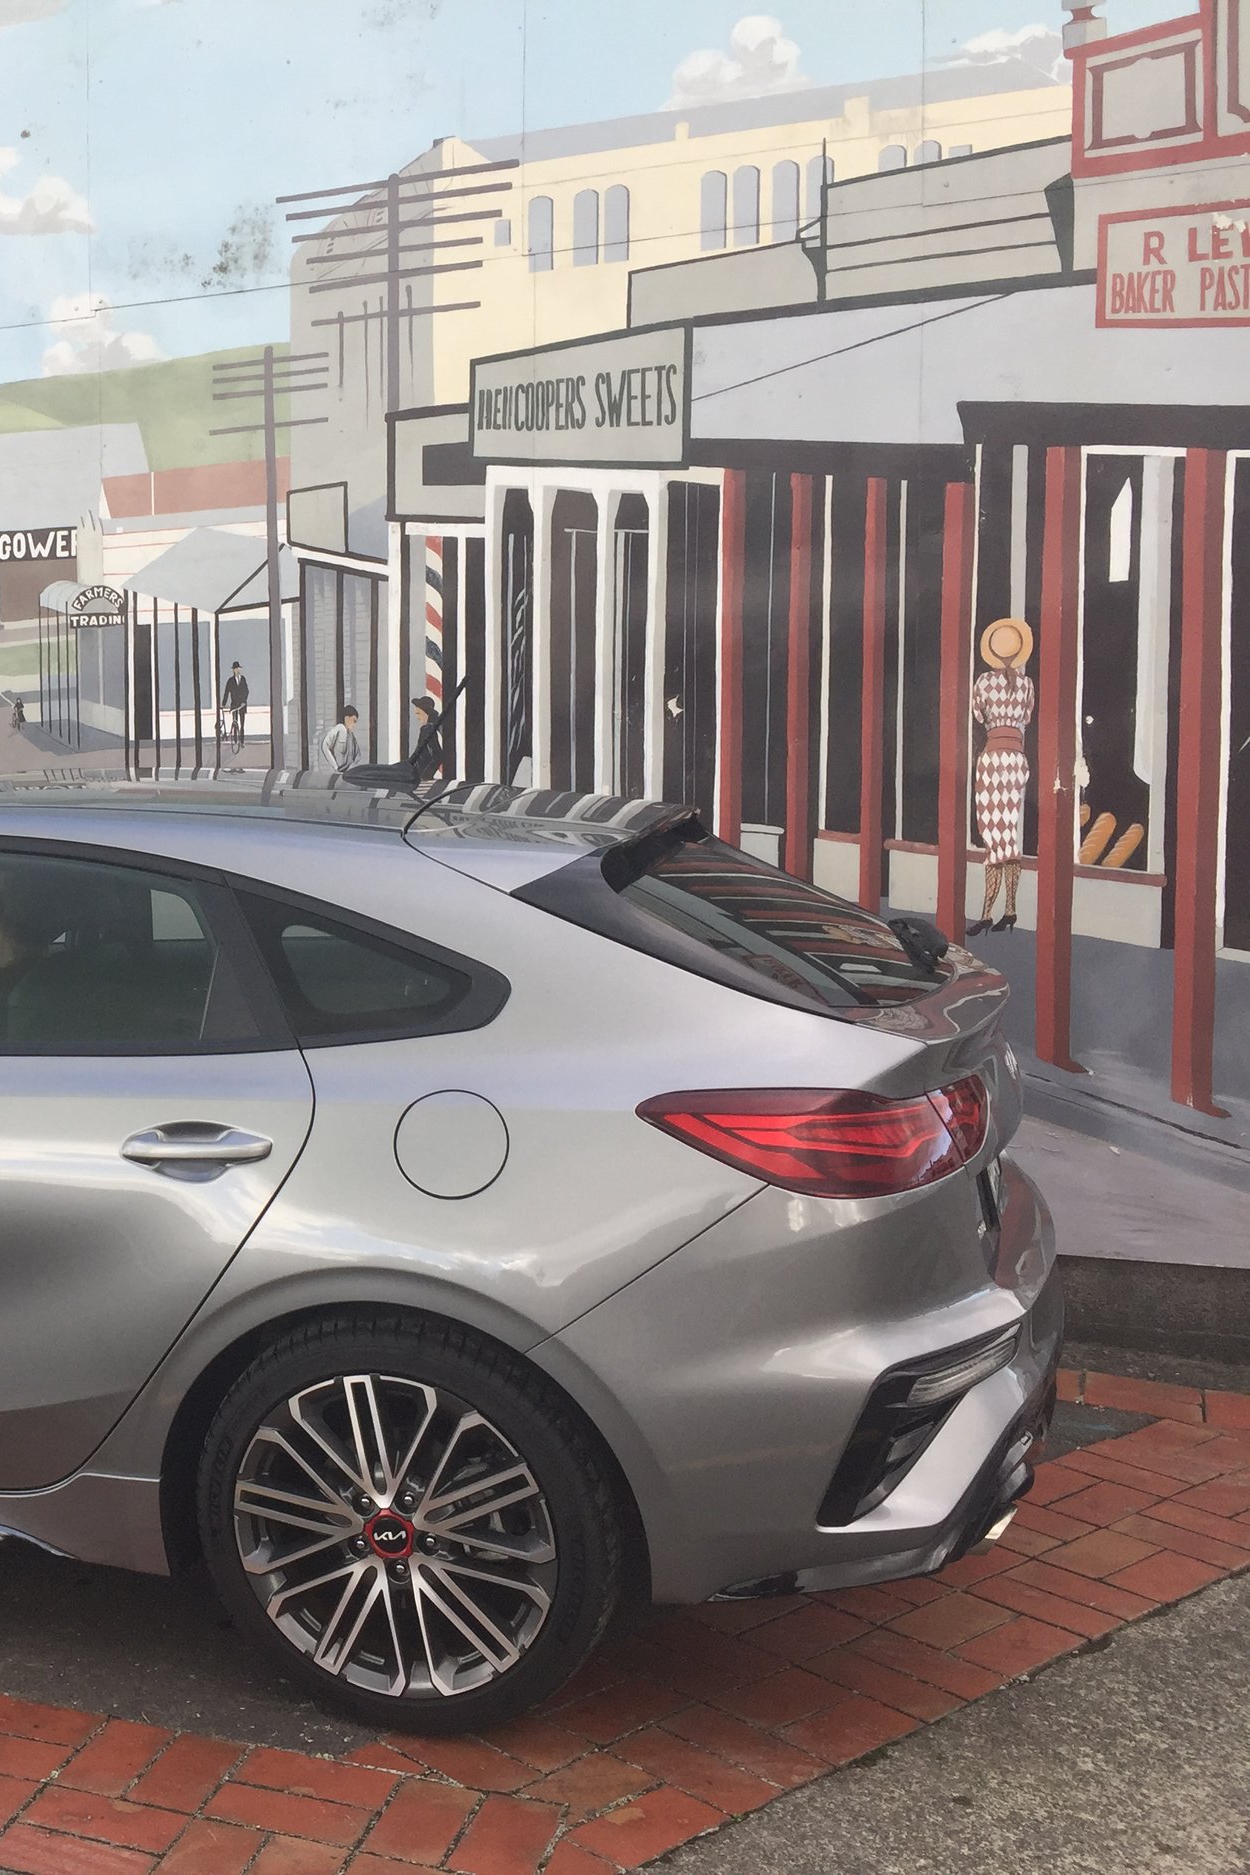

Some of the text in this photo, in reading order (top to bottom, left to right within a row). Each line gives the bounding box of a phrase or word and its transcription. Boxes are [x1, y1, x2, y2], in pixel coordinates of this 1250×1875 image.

[1143, 231, 1167, 266] R
[1111, 263, 1250, 314] BAKER PAST
[594, 364, 677, 428] SWEETS
[73, 587, 124, 611] FARMERS
[71, 615, 125, 627] TRADIN
